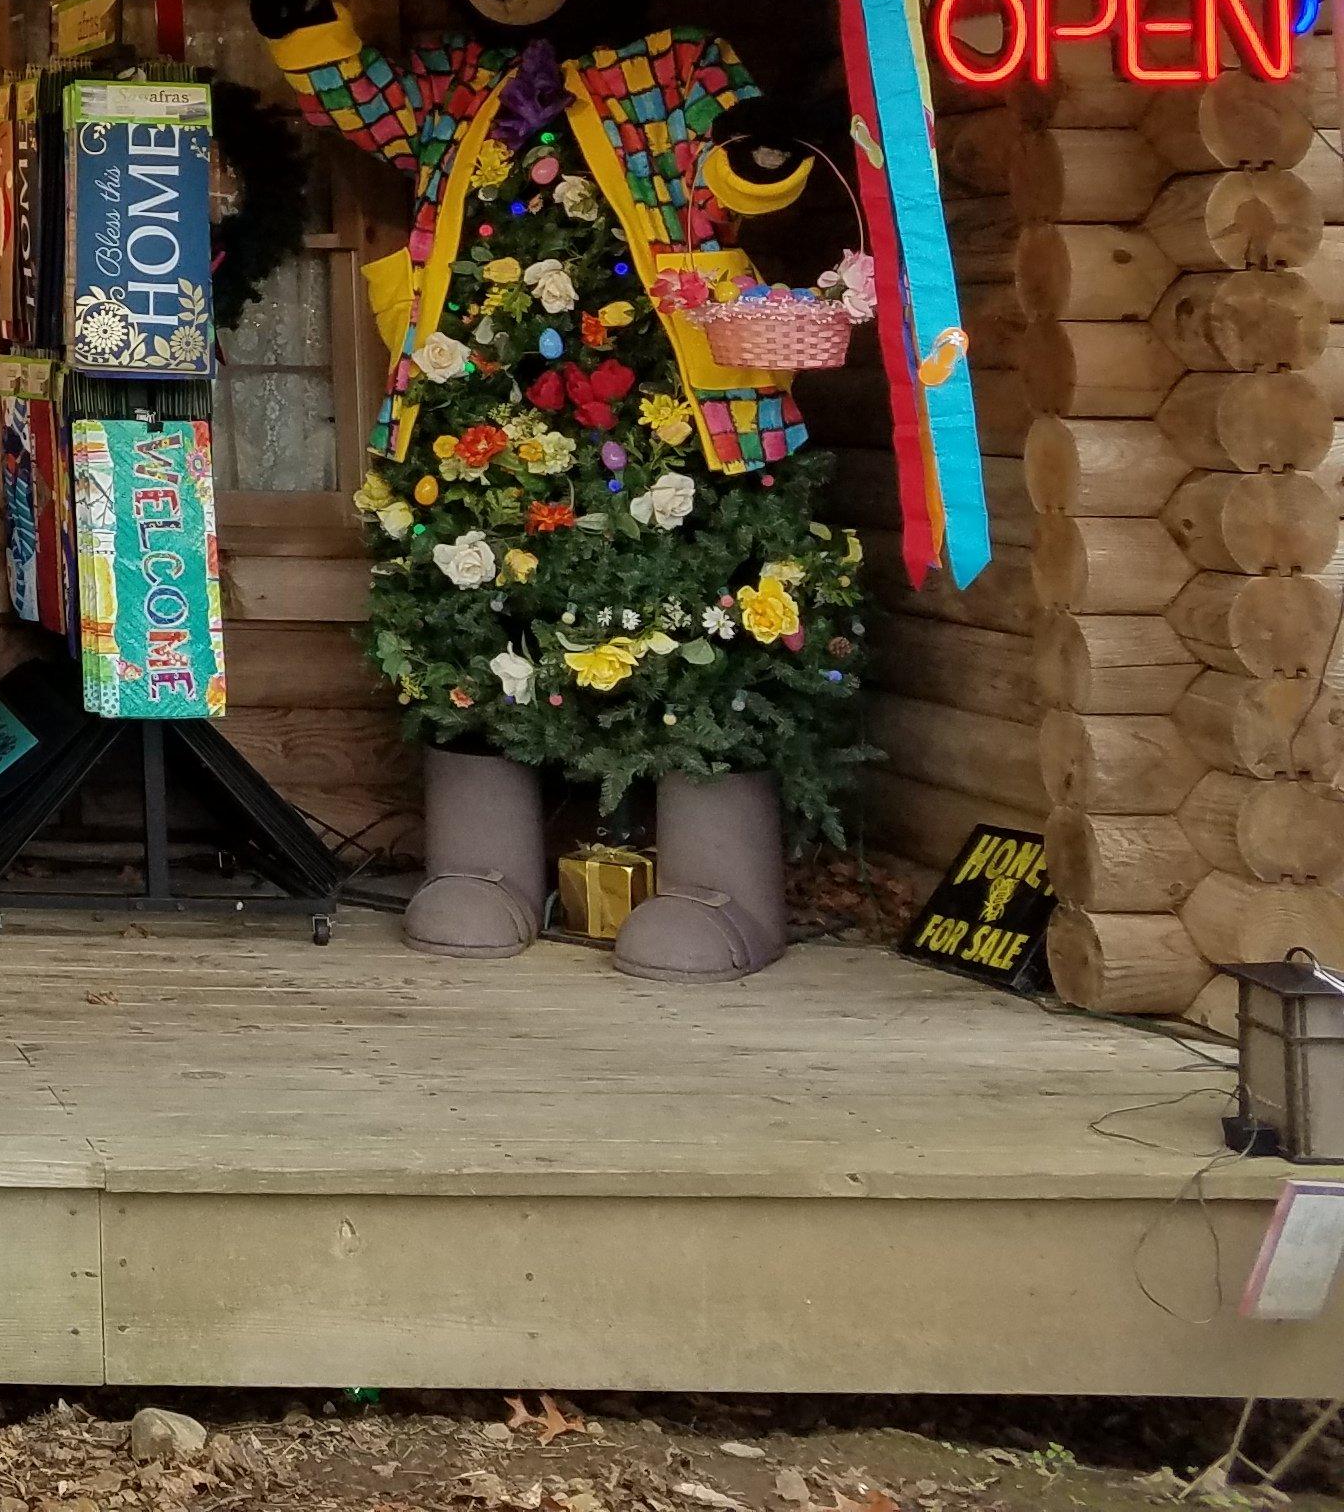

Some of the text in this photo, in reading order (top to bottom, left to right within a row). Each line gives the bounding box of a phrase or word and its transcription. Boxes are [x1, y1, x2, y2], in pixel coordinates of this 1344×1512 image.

[94, 165, 123, 277] Bless this
[127, 122, 180, 327] HOME
[132, 430, 198, 703] WELCOME
[953, 834, 1055, 897] HONE
[915, 914, 1030, 971] FOR SALE
